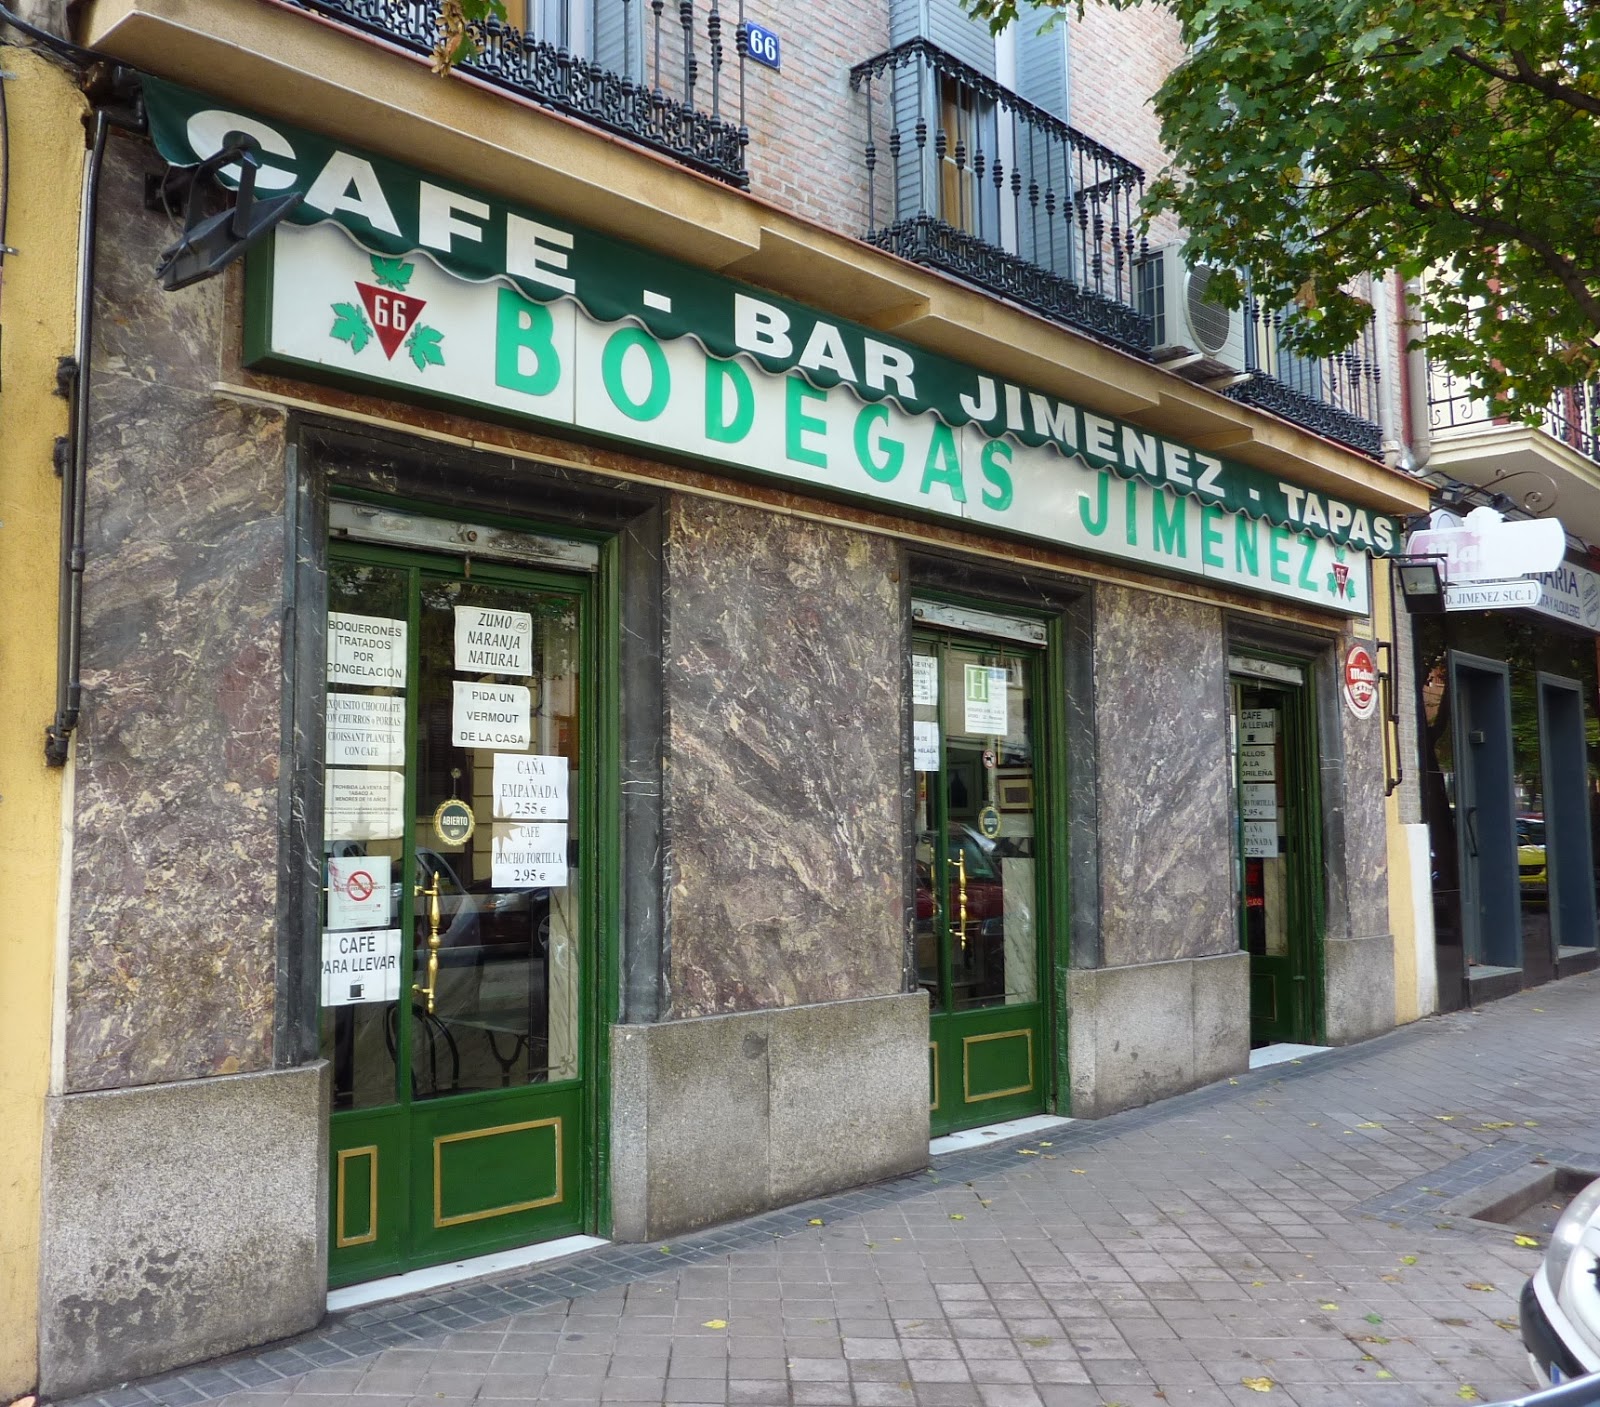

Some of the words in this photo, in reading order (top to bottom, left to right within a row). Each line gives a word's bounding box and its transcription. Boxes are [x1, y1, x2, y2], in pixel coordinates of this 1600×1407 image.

[750, 29, 776, 61] 66
[374, 295, 408, 331] 66
[187, 109, 576, 294] CAFE
[734, 292, 918, 401] BAR
[959, 375, 1226, 498] JIMENEZ
[1279, 482, 1394, 552] TAPAS
[495, 287, 1013, 512] BODEGAS
[1078, 471, 1319, 592] JIMENEZ
[1457, 591, 1499, 605] JIMENEZ
[1503, 589, 1524, 601] SUC.
[477, 612, 513, 629] ZUMO
[328, 620, 402, 637] BOQUERONES
[338, 635, 391, 650] TRATADOS
[467, 630, 520, 651] NARANJA
[353, 651, 374, 662] POR
[468, 650, 520, 668] NATURAL
[472, 690, 496, 702] PIDA
[499, 693, 514, 703] UN
[327, 699, 360, 711] XQUISITO
[361, 701, 401, 713] CHOCOLATE
[326, 713, 336, 722] ON
[338, 714, 370, 724] CHURROS
[375, 716, 401, 727] PORRAS
[466, 711, 519, 723] VERMOUT
[1249, 721, 1274, 729] LLEVAR
[328, 731, 365, 743] CROISSANT
[366, 733, 396, 744] PLANCHA
[460, 731, 475, 741] DE
[479, 732, 492, 742] LA
[495, 733, 524, 744] CASA
[344, 746, 360, 756] CON
[517, 757, 545, 775] CAÑA
[501, 784, 559, 799] EMPANADA
[442, 816, 468, 826] ABIERTO
[520, 826, 540, 838] CAFE
[495, 852, 525, 864] PINCHO
[527, 852, 563, 864] TORTILLA
[352, 955, 395, 972] LLEVAR
